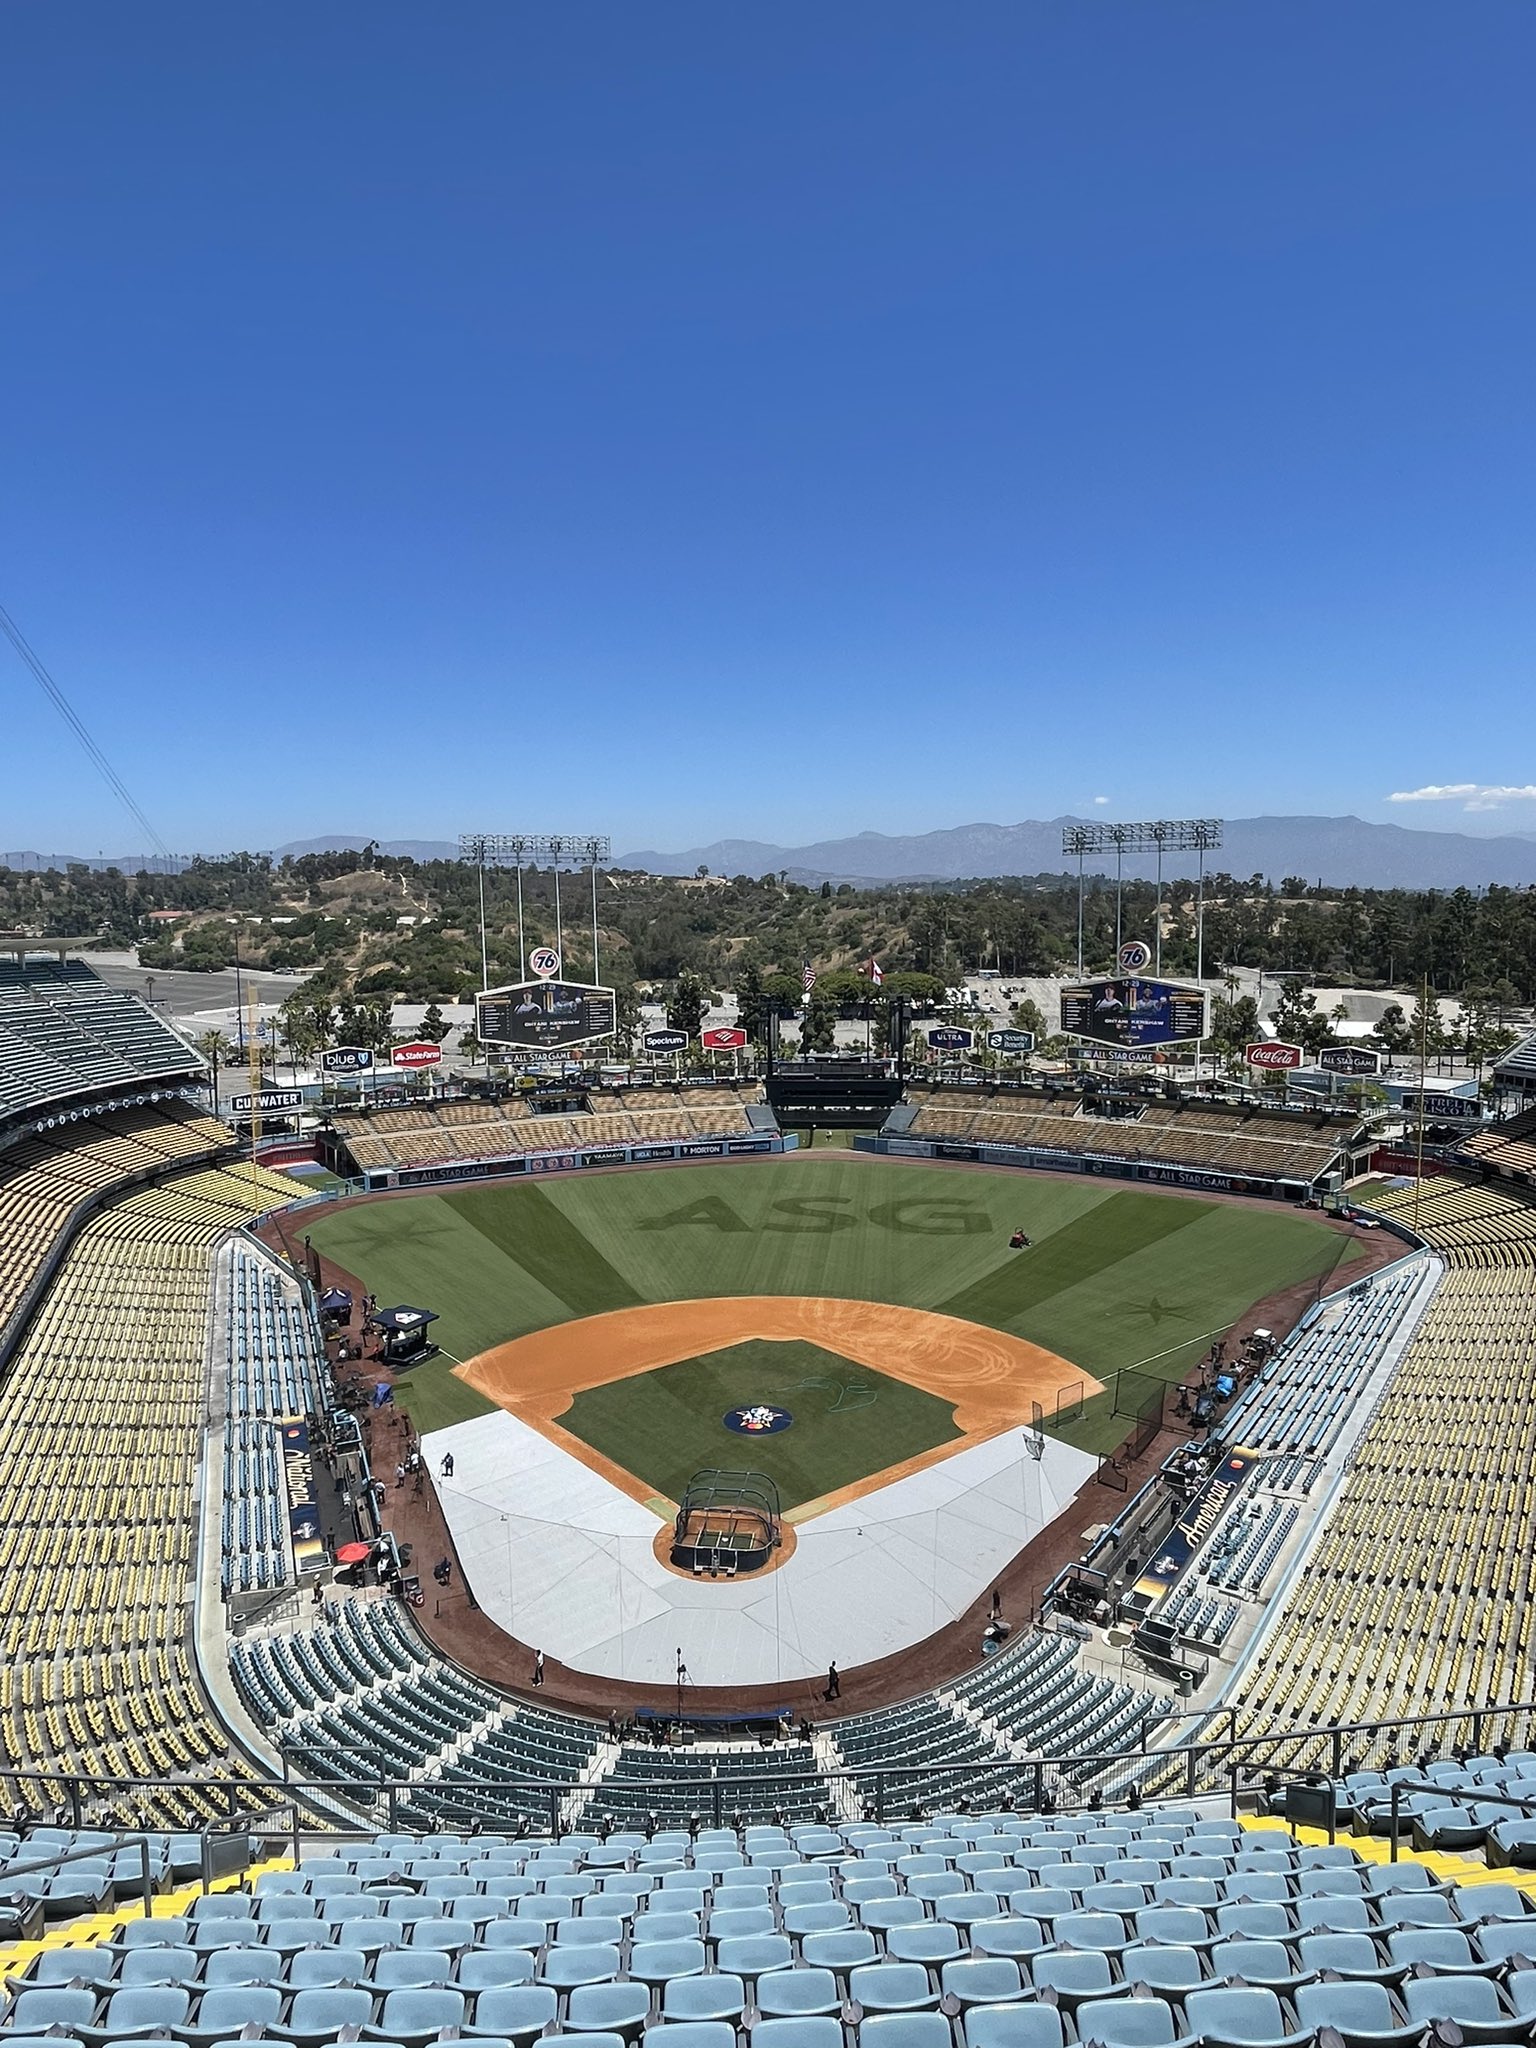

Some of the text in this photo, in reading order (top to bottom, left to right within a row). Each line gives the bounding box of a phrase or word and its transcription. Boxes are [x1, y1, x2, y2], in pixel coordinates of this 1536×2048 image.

[535, 952, 556, 969] 76
[1121, 948, 1145, 965] 76
[646, 1037, 684, 1047] Spectrum
[937, 1033, 963, 1041] ULTRA
[326, 1053, 356, 1065] blue
[514, 1052, 571, 1063] ALL STAR GAME
[1093, 1051, 1153, 1062] ALL STAR GAME
[1354, 1058, 1376, 1067] GAME
[236, 1093, 299, 1110] CUTWATER
[689, 1146, 720, 1154] MORTON
[421, 1165, 489, 1181] ALL STAR GAME
[1160, 1170, 1232, 1189] ALL STAR GAME
[636, 1196, 993, 1235] ASG
[284, 1449, 317, 1510] National
[1177, 1478, 1238, 1549] American
